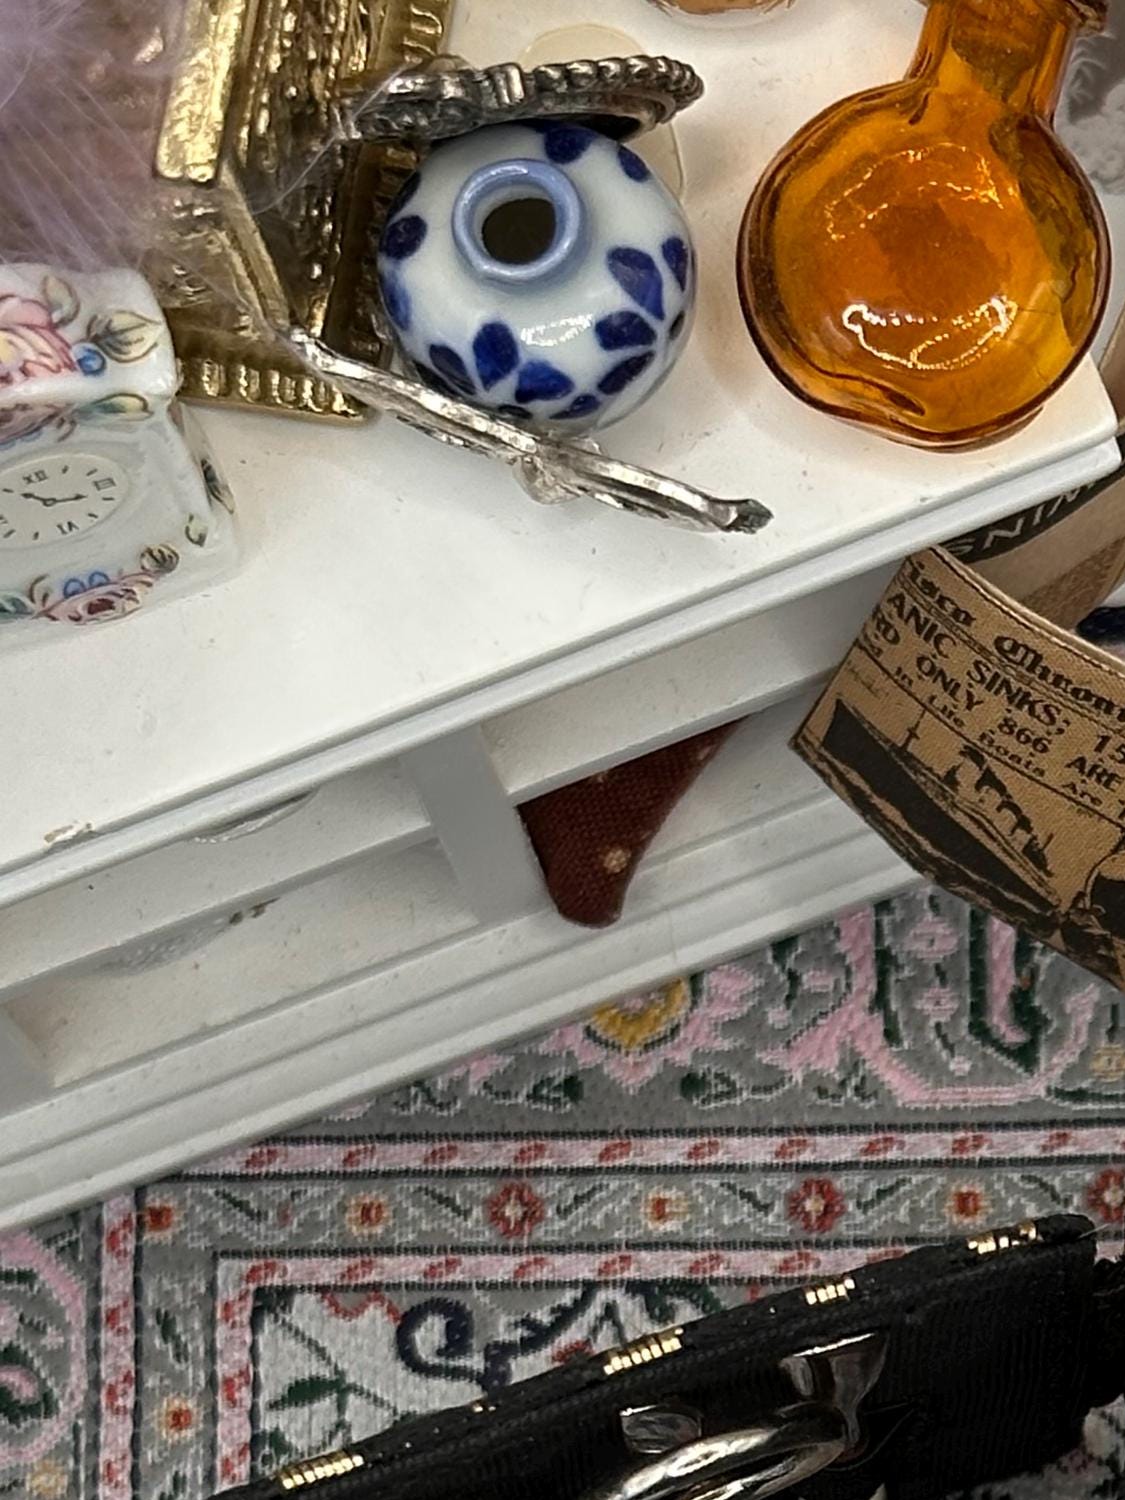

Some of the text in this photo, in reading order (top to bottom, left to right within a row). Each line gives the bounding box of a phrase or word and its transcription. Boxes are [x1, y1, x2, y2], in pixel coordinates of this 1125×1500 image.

[887, 592, 957, 659] ANIC
[965, 658, 1071, 736] SINKS;
[915, 655, 984, 711] ONLY
[997, 716, 1053, 754] 866
[1063, 755, 1124, 793] ARE
